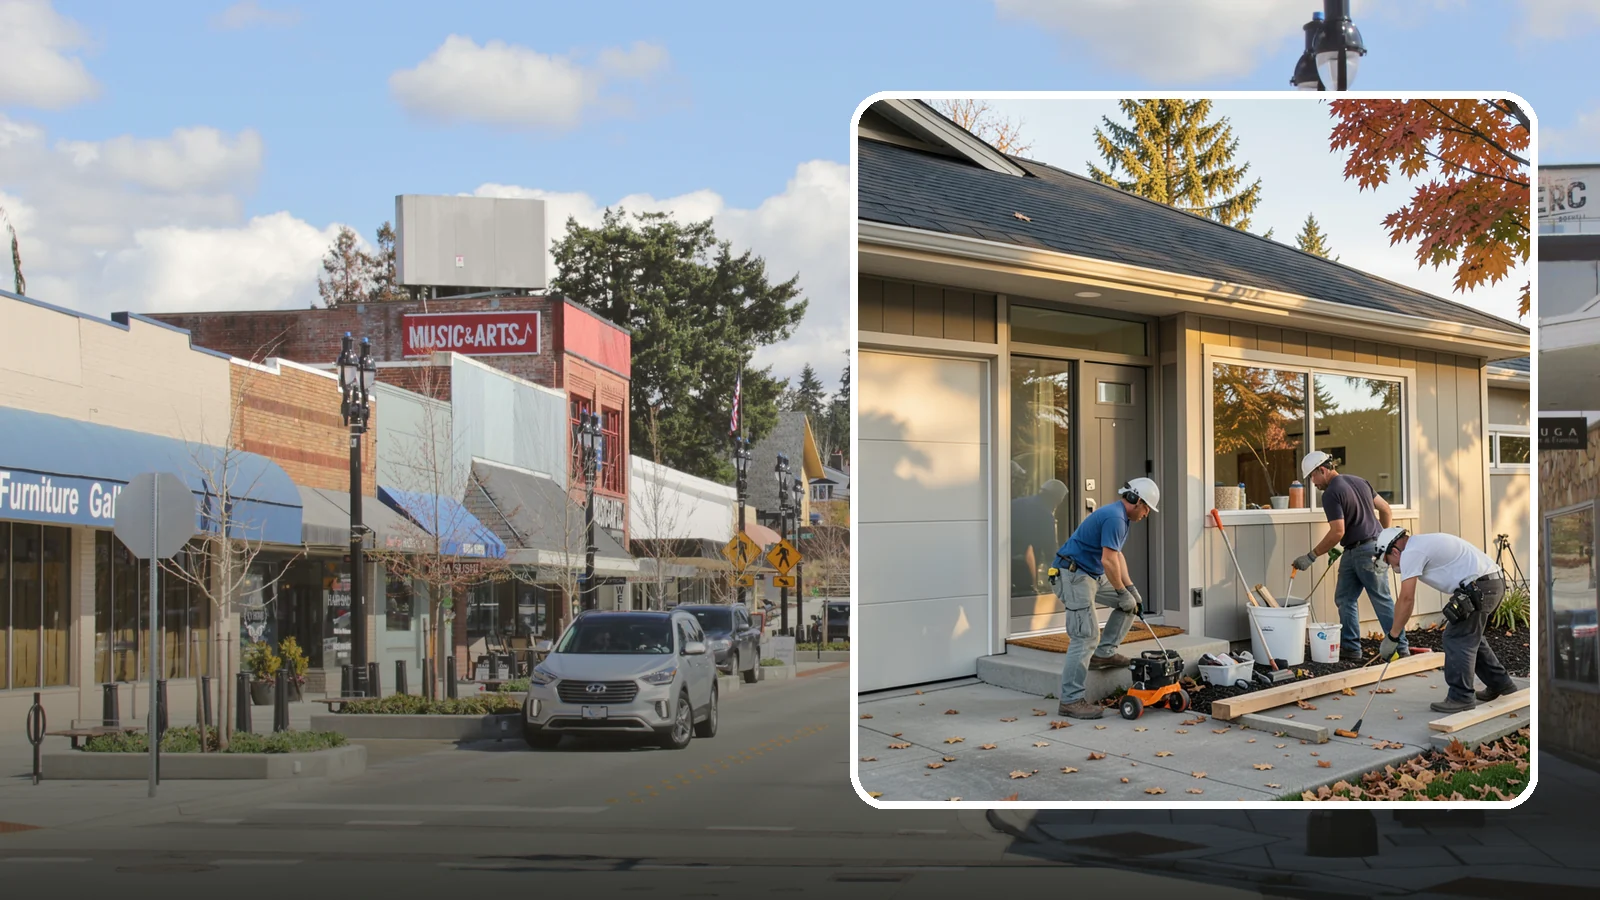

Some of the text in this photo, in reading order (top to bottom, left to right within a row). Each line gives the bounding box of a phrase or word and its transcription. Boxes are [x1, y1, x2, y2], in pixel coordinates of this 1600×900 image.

[0, 471, 121, 519] Furniture Gal
[453, 563, 479, 574] SUSHI
